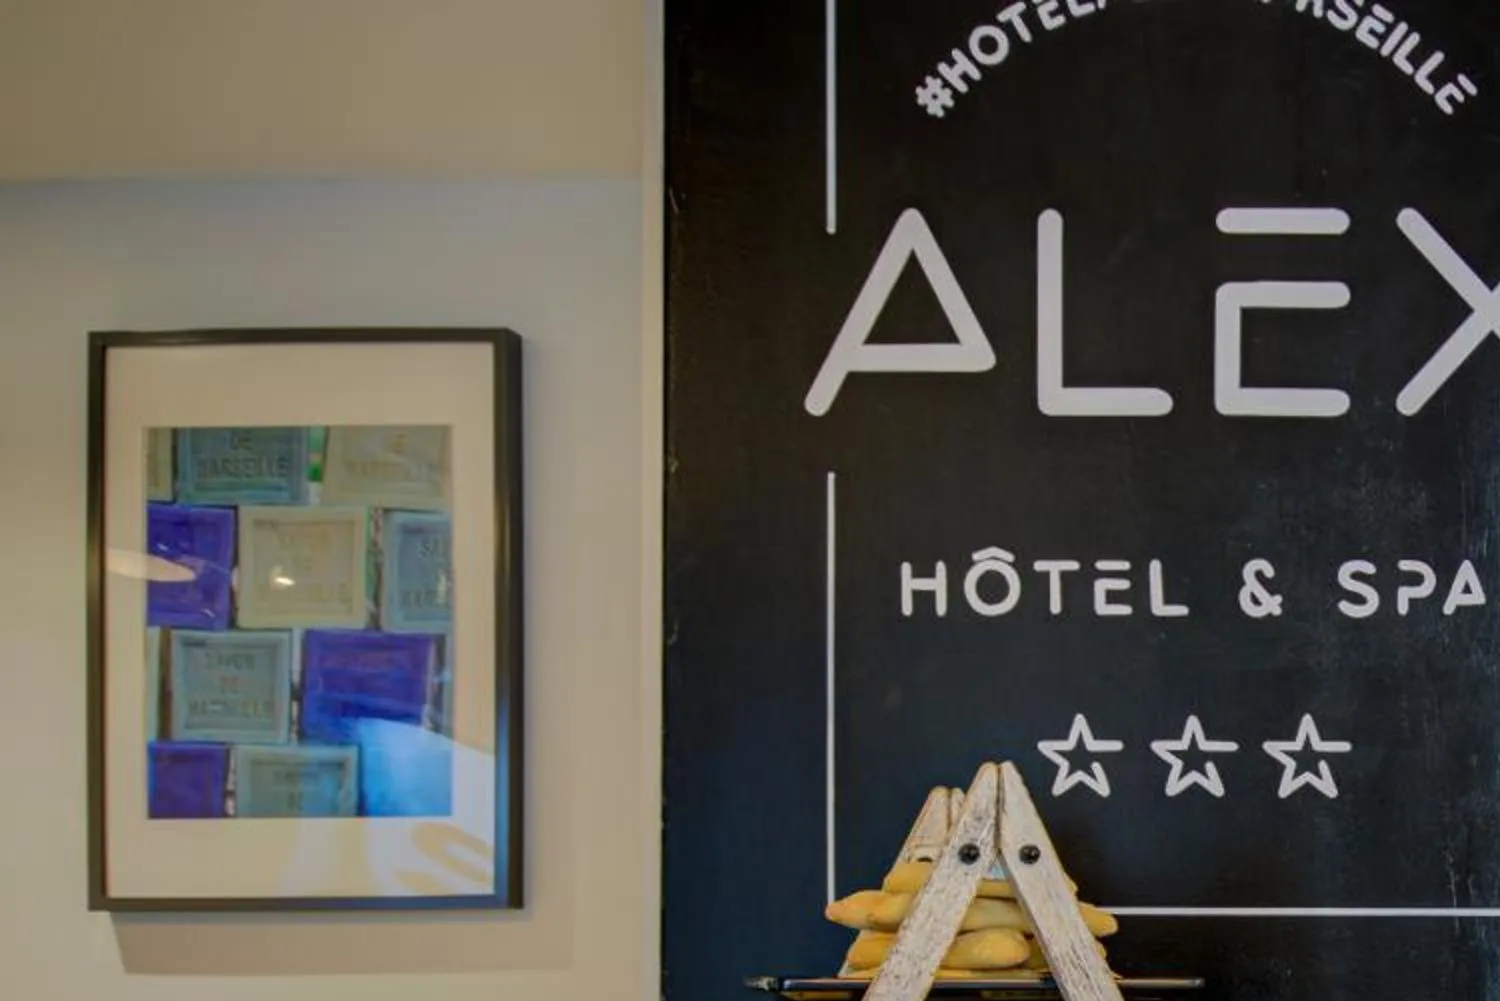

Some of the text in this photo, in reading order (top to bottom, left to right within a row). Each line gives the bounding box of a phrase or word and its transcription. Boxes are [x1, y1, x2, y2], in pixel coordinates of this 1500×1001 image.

[900, 546, 1486, 618] HÔTEL & SPA
